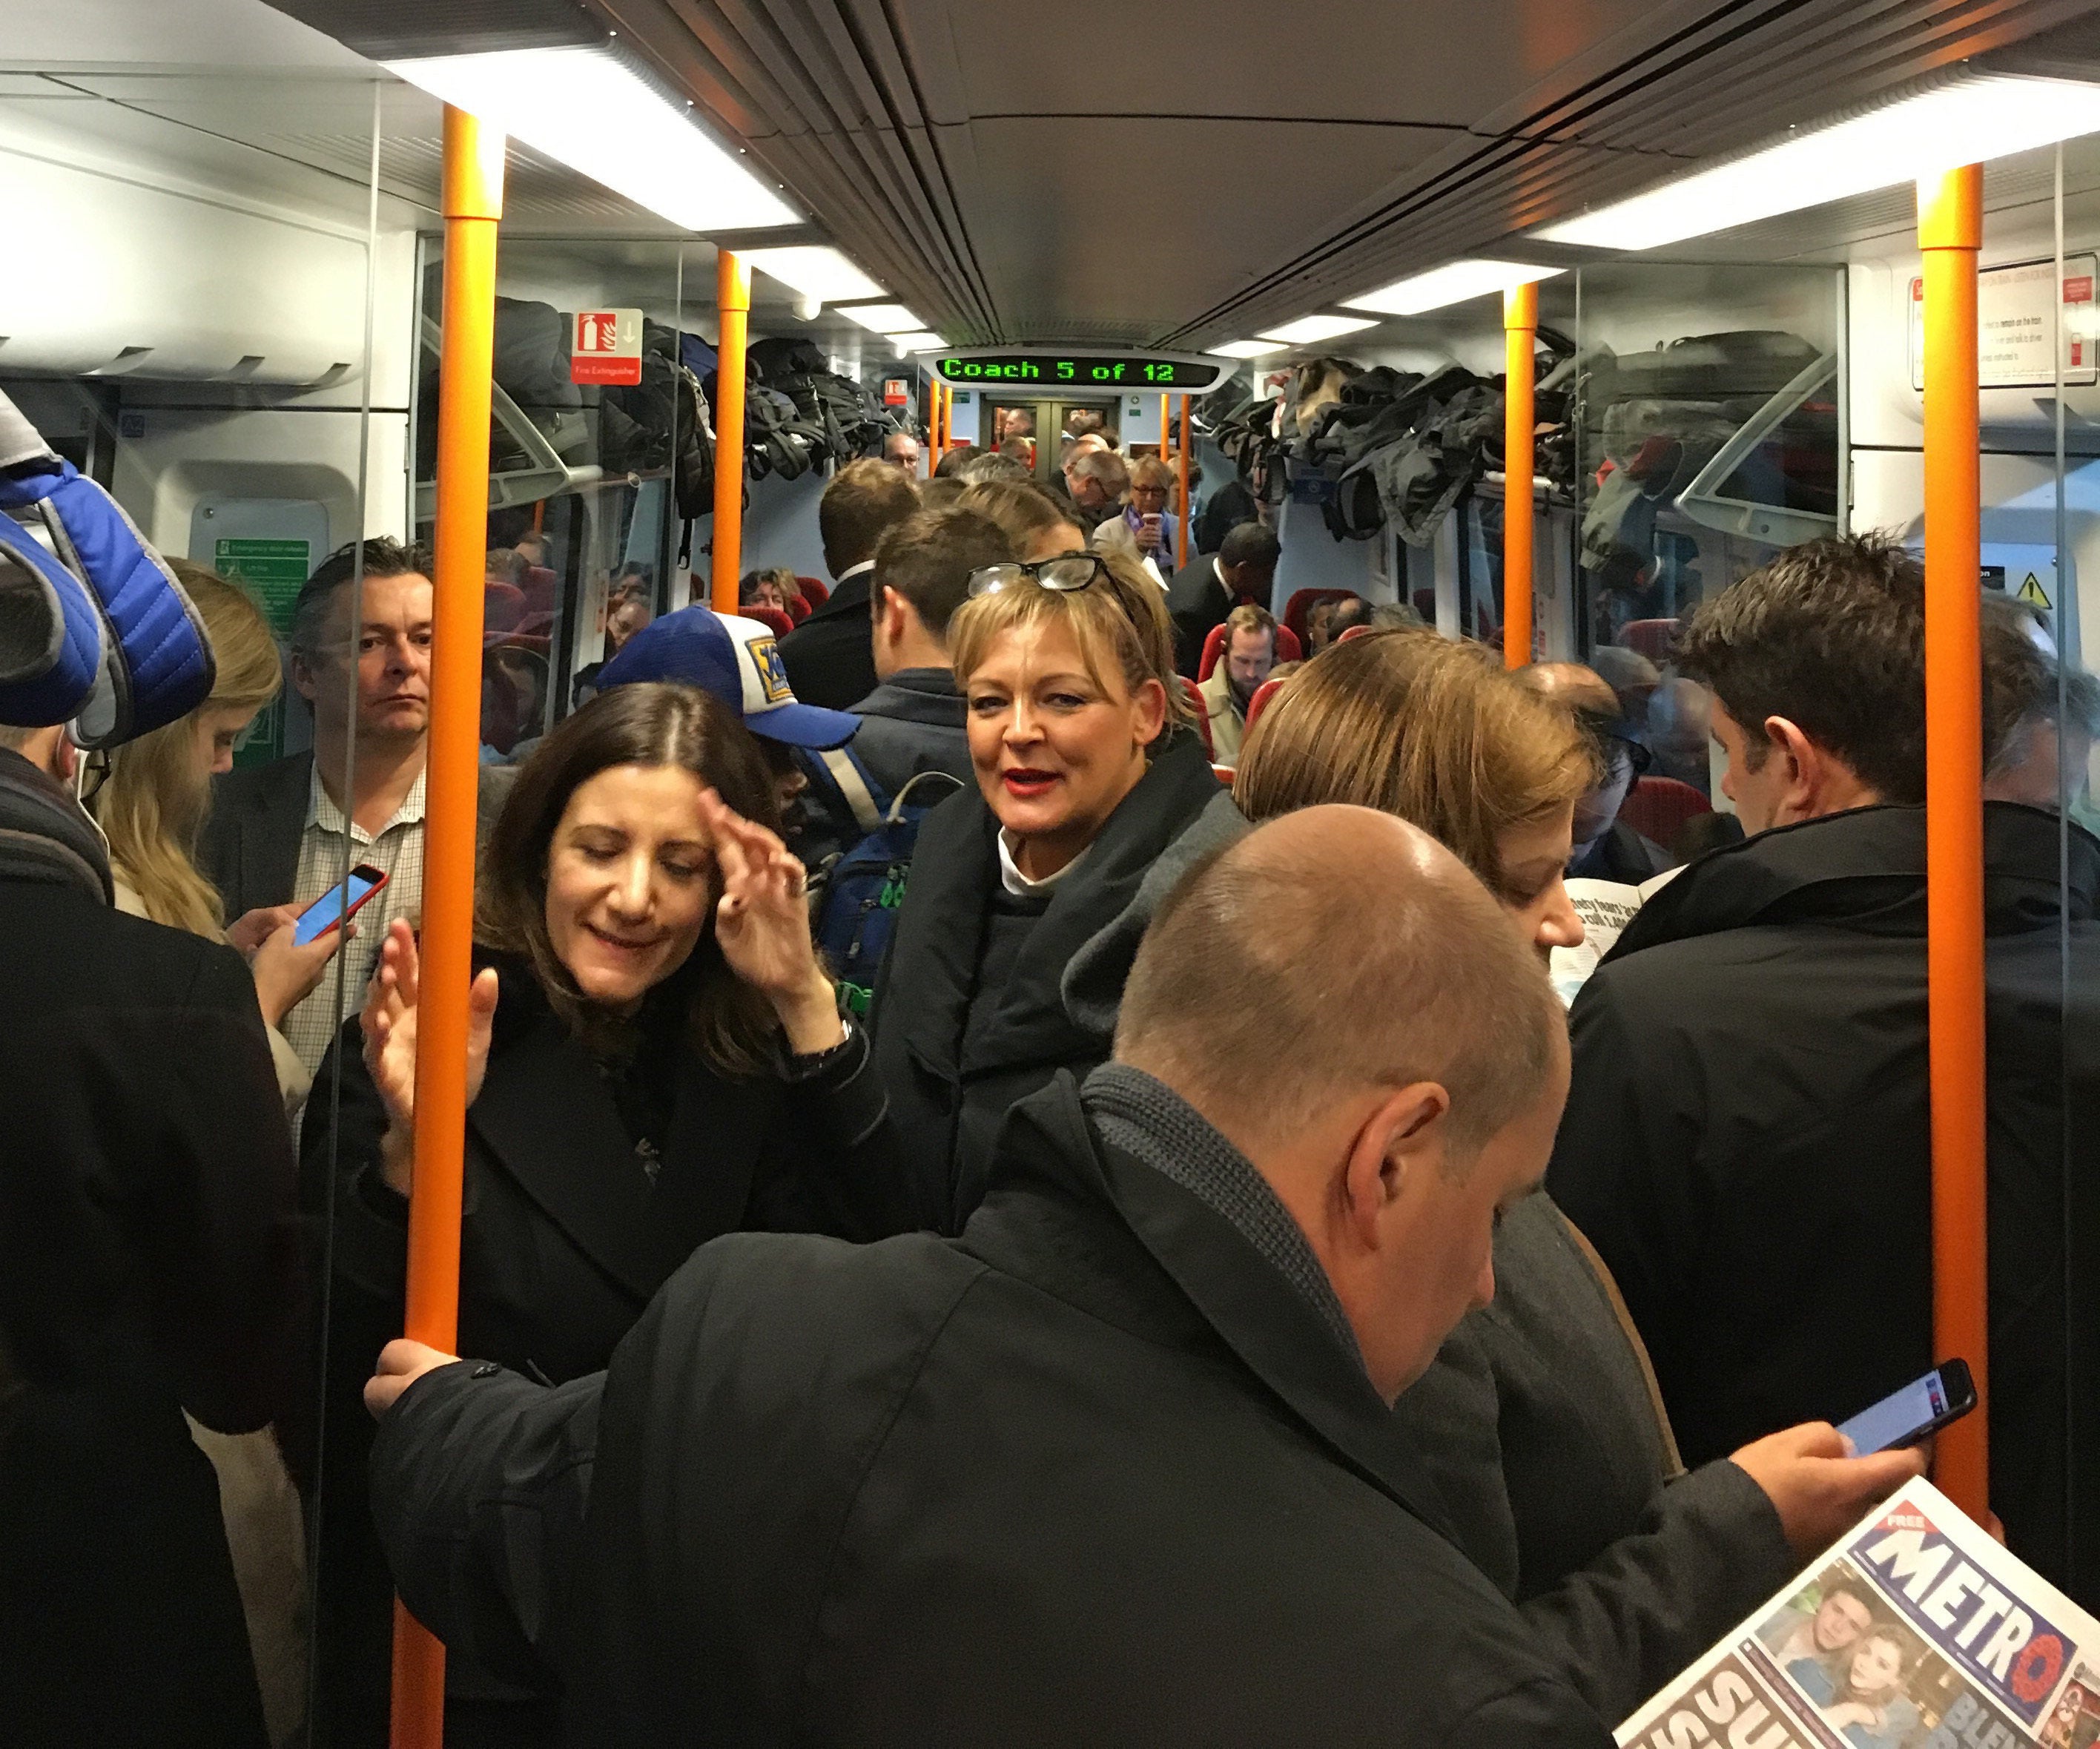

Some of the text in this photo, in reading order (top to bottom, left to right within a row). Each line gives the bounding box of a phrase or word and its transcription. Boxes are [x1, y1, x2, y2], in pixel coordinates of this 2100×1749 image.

[575, 366, 635, 377] Fire Extinguisher
[944, 359, 1175, 381] Coach 5 of 12
[1887, 1514, 1925, 1529] FREE
[1866, 1528, 2063, 1703] METRO
